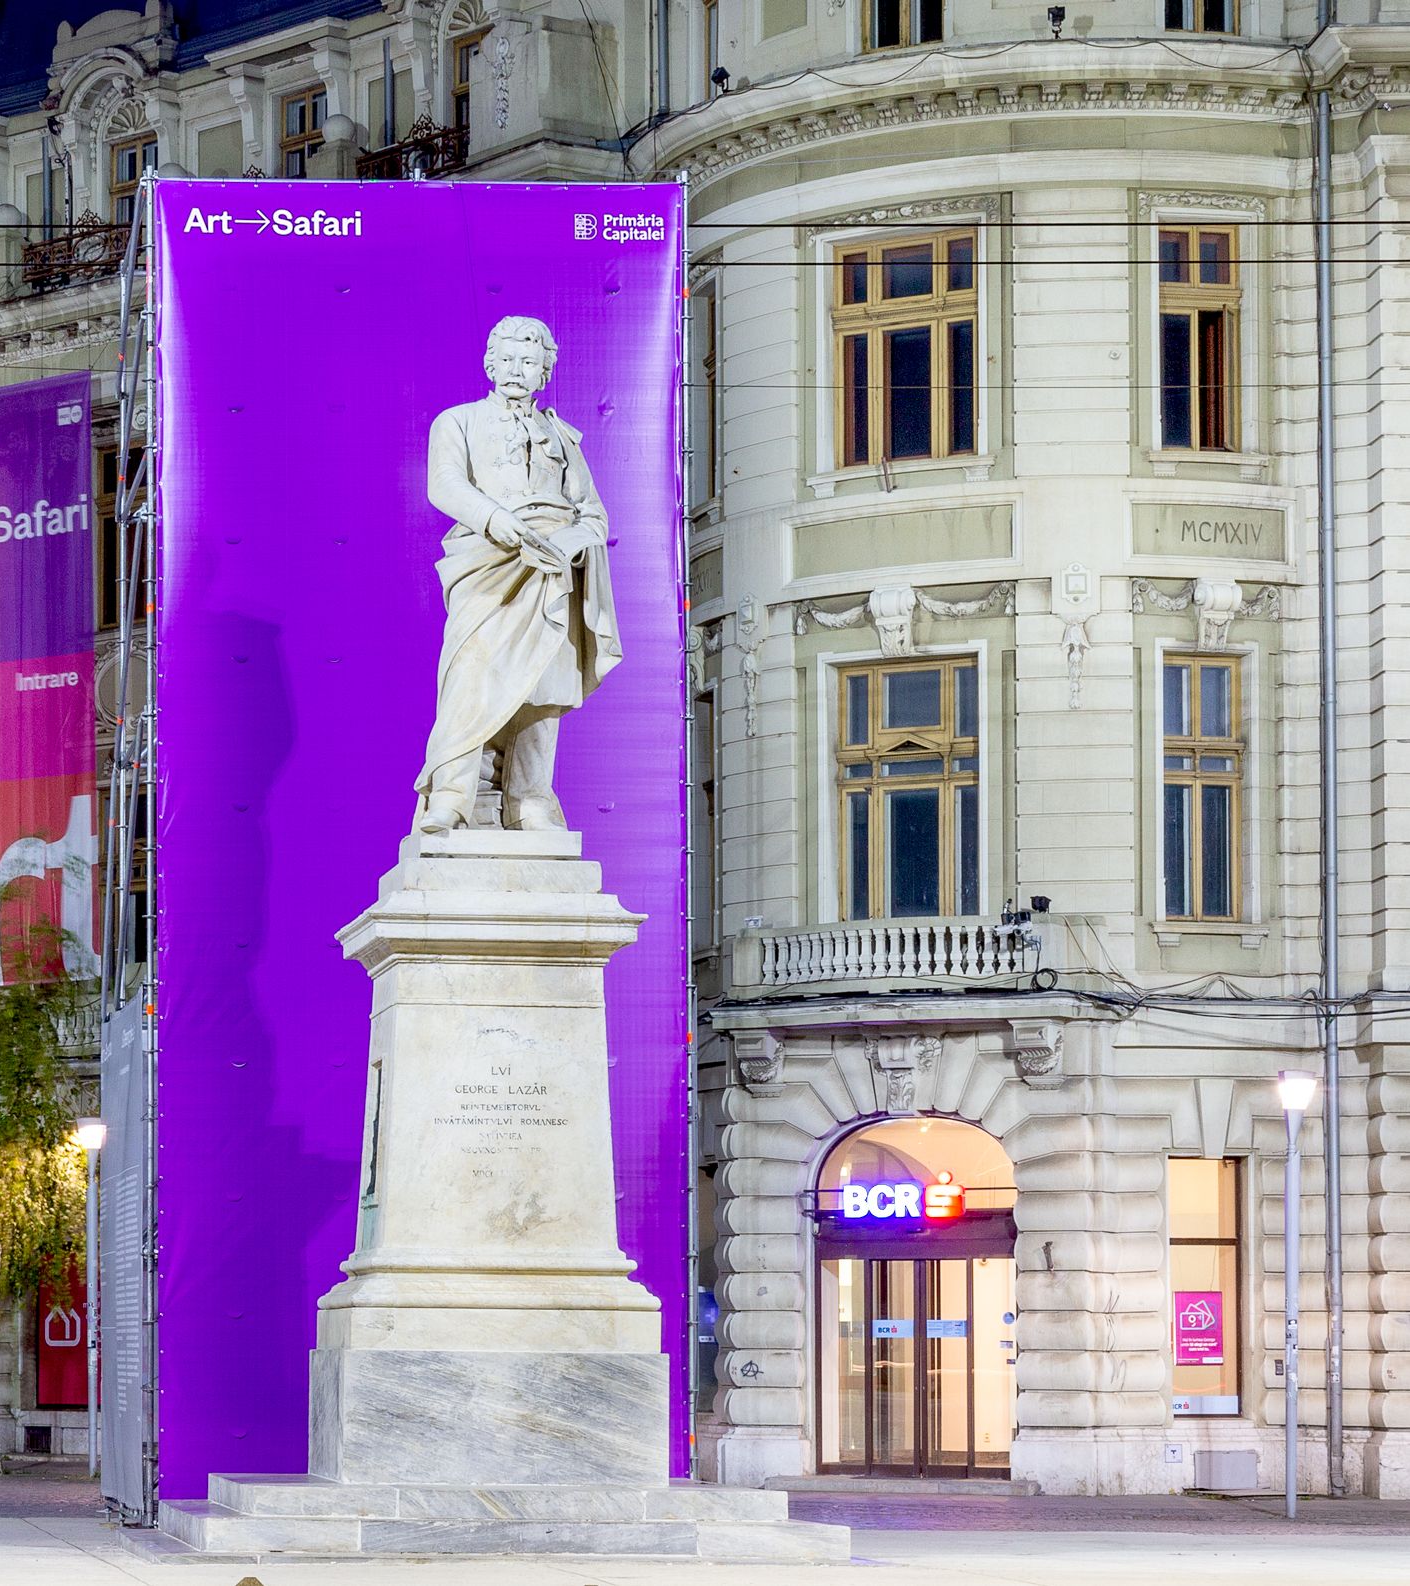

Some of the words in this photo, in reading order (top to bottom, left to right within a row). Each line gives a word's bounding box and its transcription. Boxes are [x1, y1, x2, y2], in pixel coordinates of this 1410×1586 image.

[183, 207, 233, 234] Art
[272, 209, 362, 236] Safari
[603, 213, 664, 227] Primăria
[602, 227, 665, 244] Capitalei
[1181, 520, 1263, 545] MCMXIV
[15, 671, 79, 691] Intrare
[454, 1085, 498, 1094] GEORGE
[843, 1183, 922, 1218] BCR
